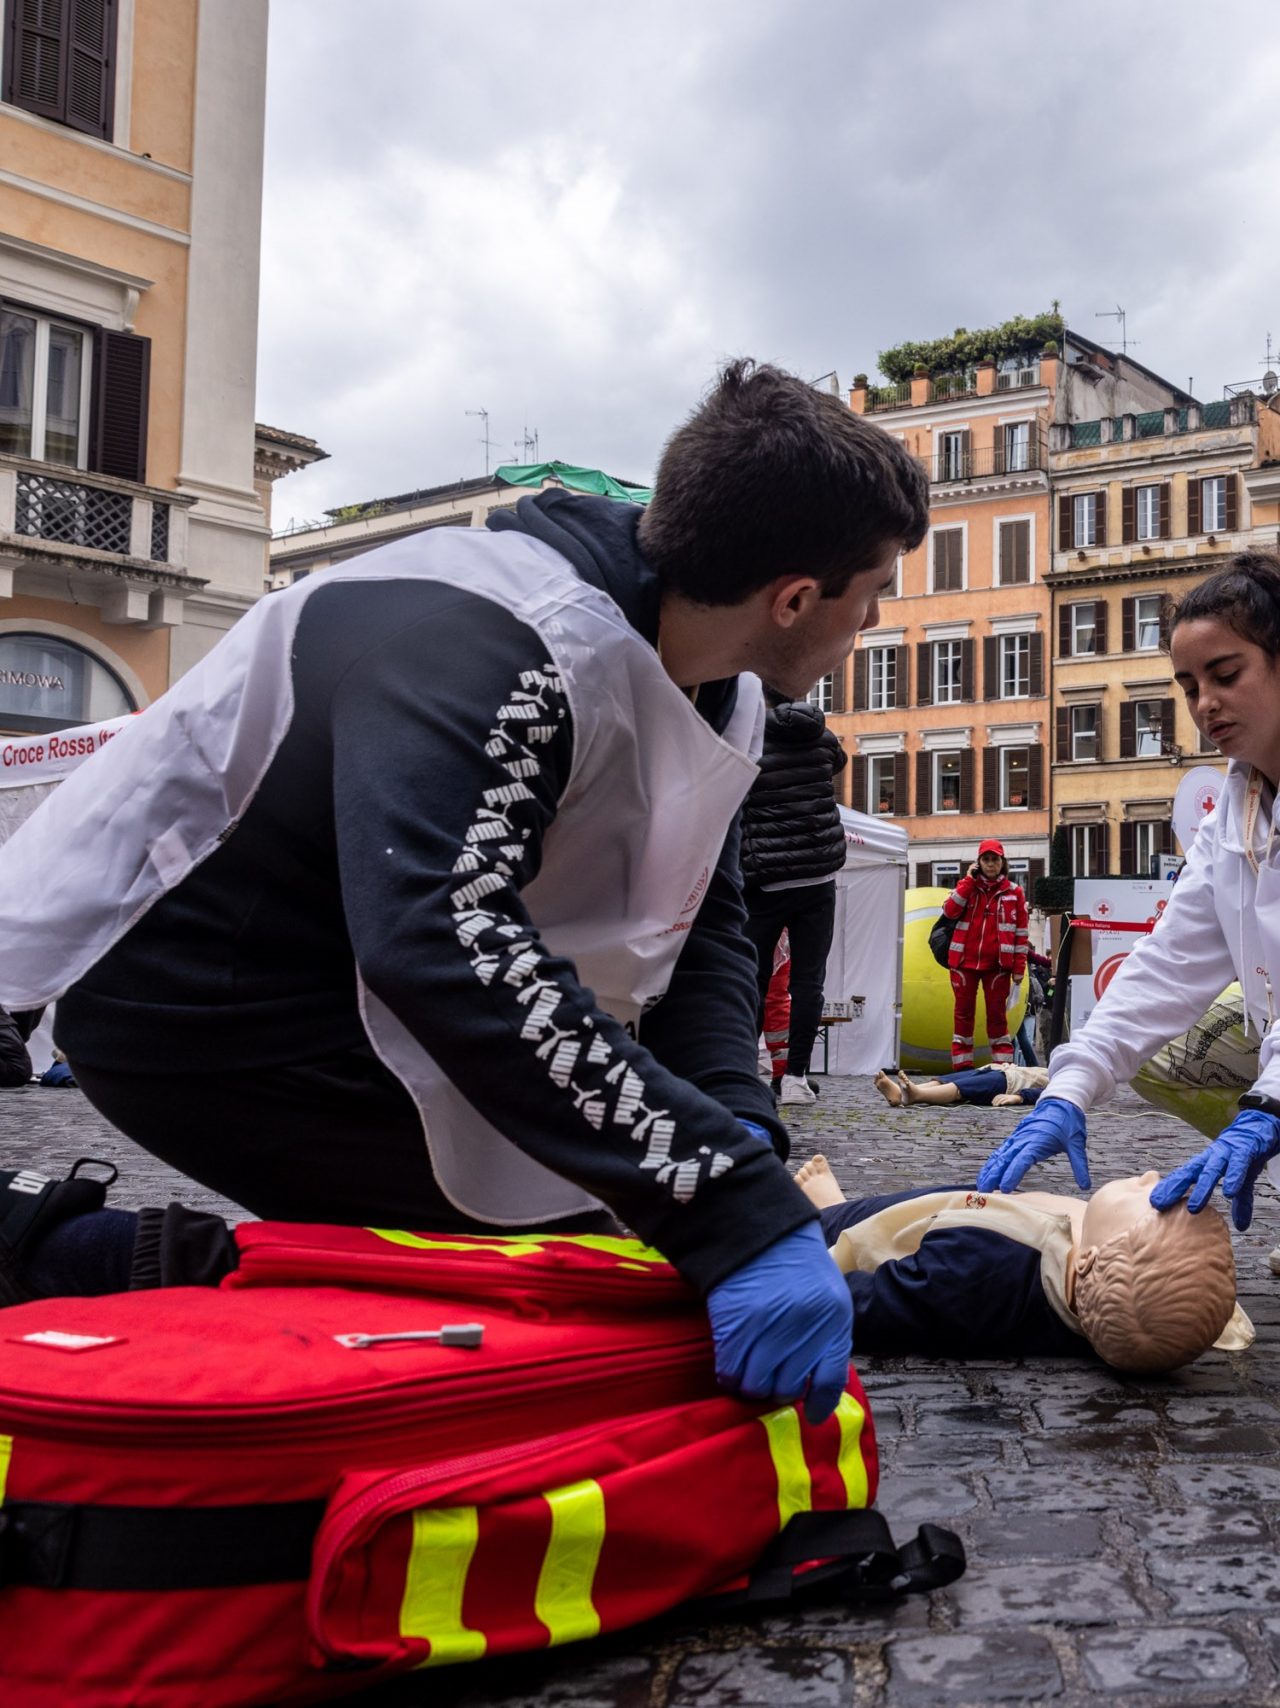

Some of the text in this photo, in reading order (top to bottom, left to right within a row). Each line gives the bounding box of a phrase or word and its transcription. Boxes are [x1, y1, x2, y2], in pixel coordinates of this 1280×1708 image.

[496, 702, 541, 720] UMA
[2, 744, 45, 767] Croce
[48, 735, 96, 760] Rossa
[465, 820, 509, 844] UMA
[638, 1118, 676, 1170] UMA
